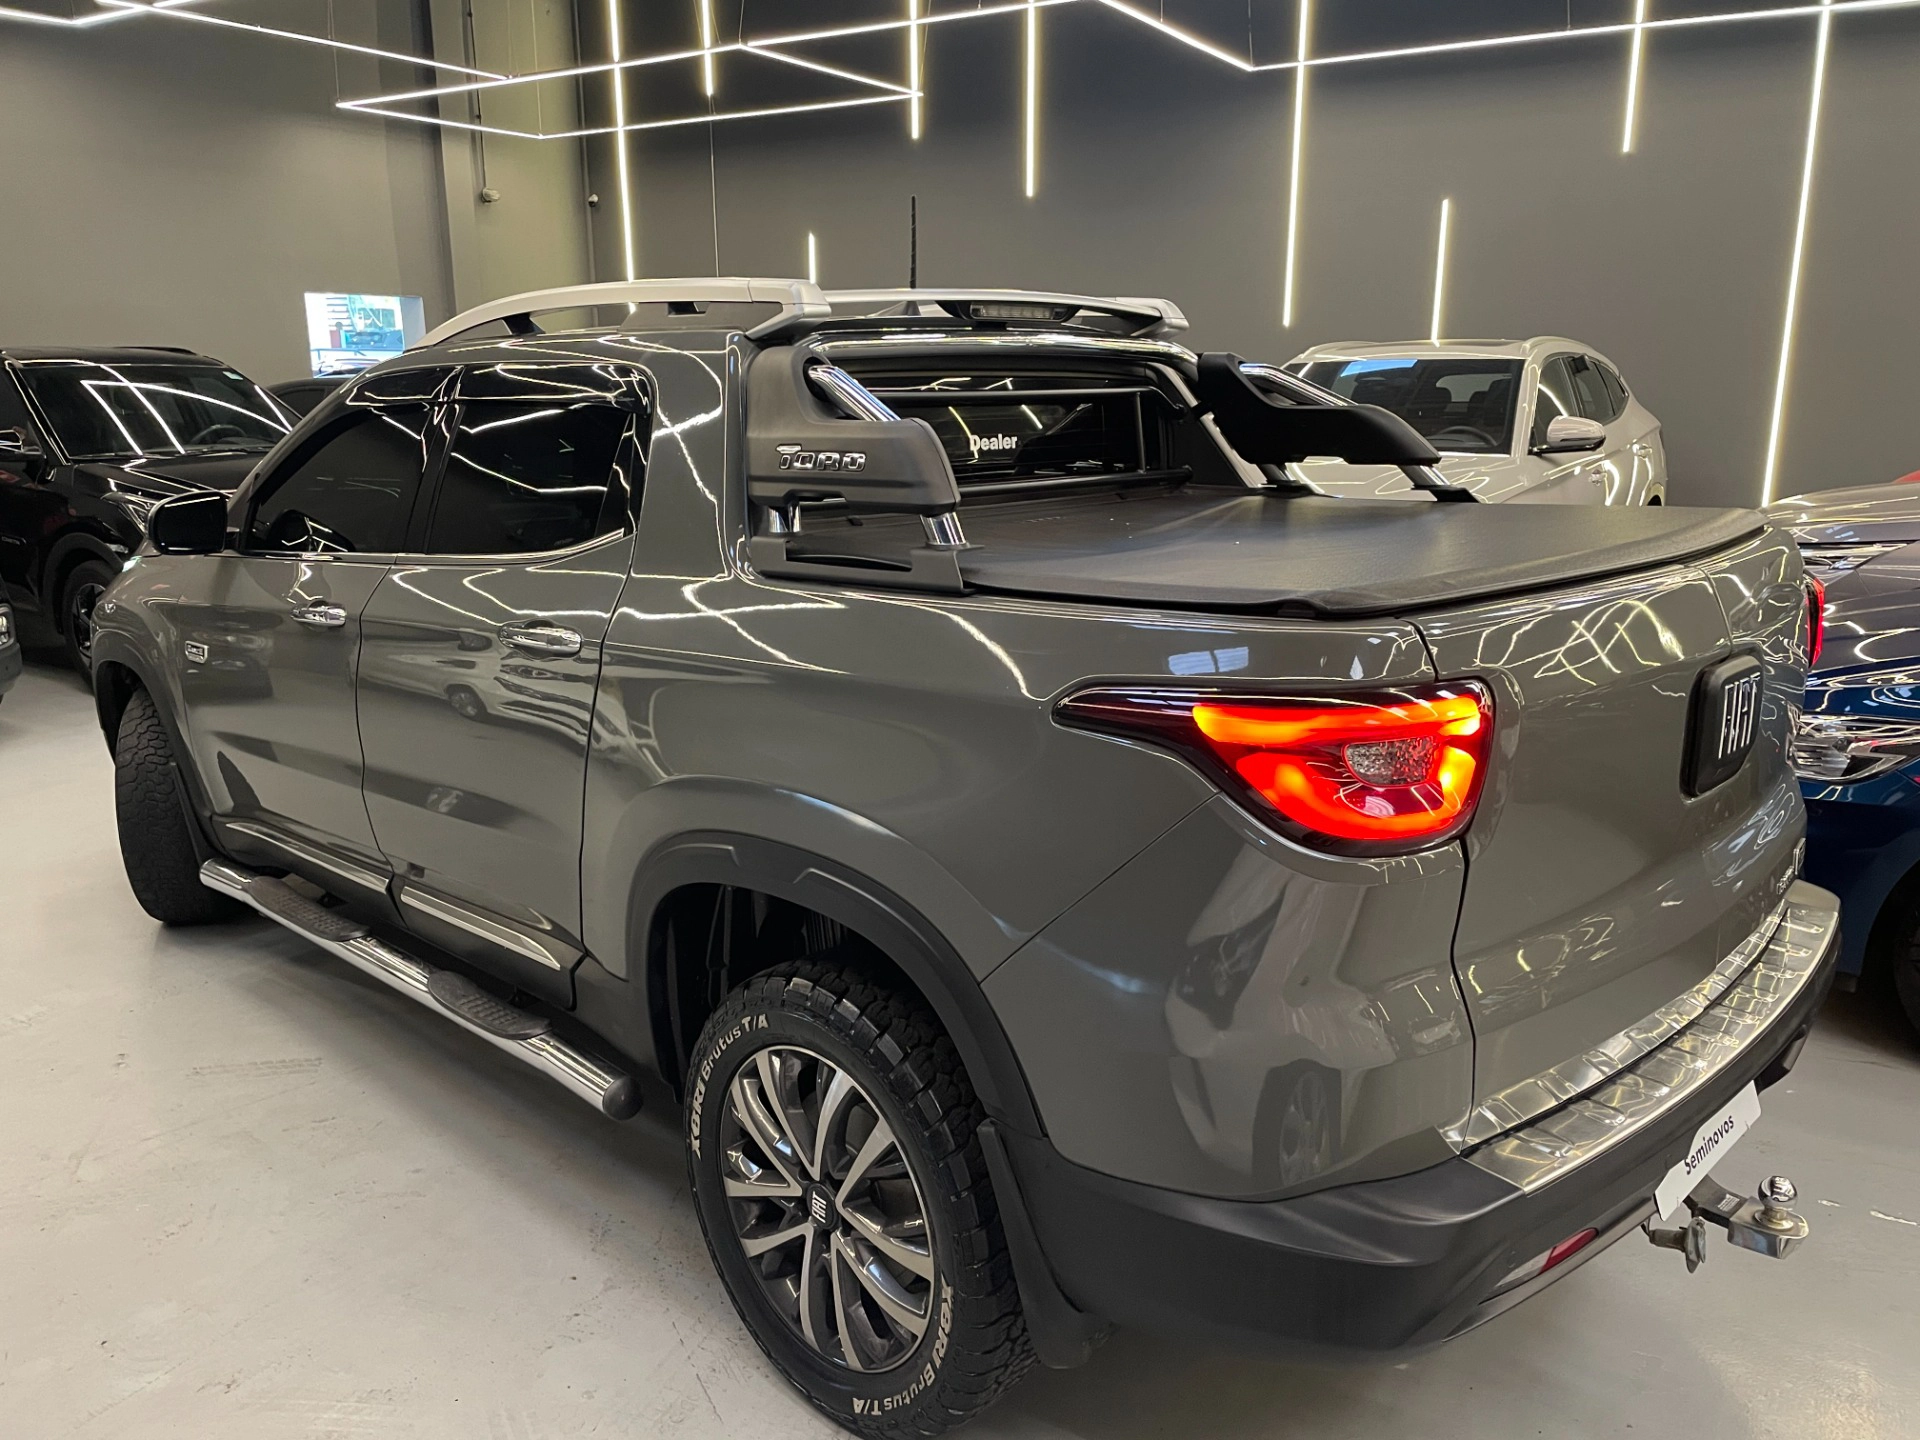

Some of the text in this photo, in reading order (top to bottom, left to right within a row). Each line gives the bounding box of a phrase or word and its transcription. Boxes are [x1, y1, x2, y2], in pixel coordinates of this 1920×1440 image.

[969, 433, 1018, 451] Dealer
[1718, 671, 1761, 760] FIAT
[701, 1025, 742, 1081] Brutus
[742, 1013, 769, 1033] T/A
[811, 1190, 827, 1224] FIAT
[852, 1397, 882, 1416] T/A
[883, 1361, 936, 1411] Brutus
